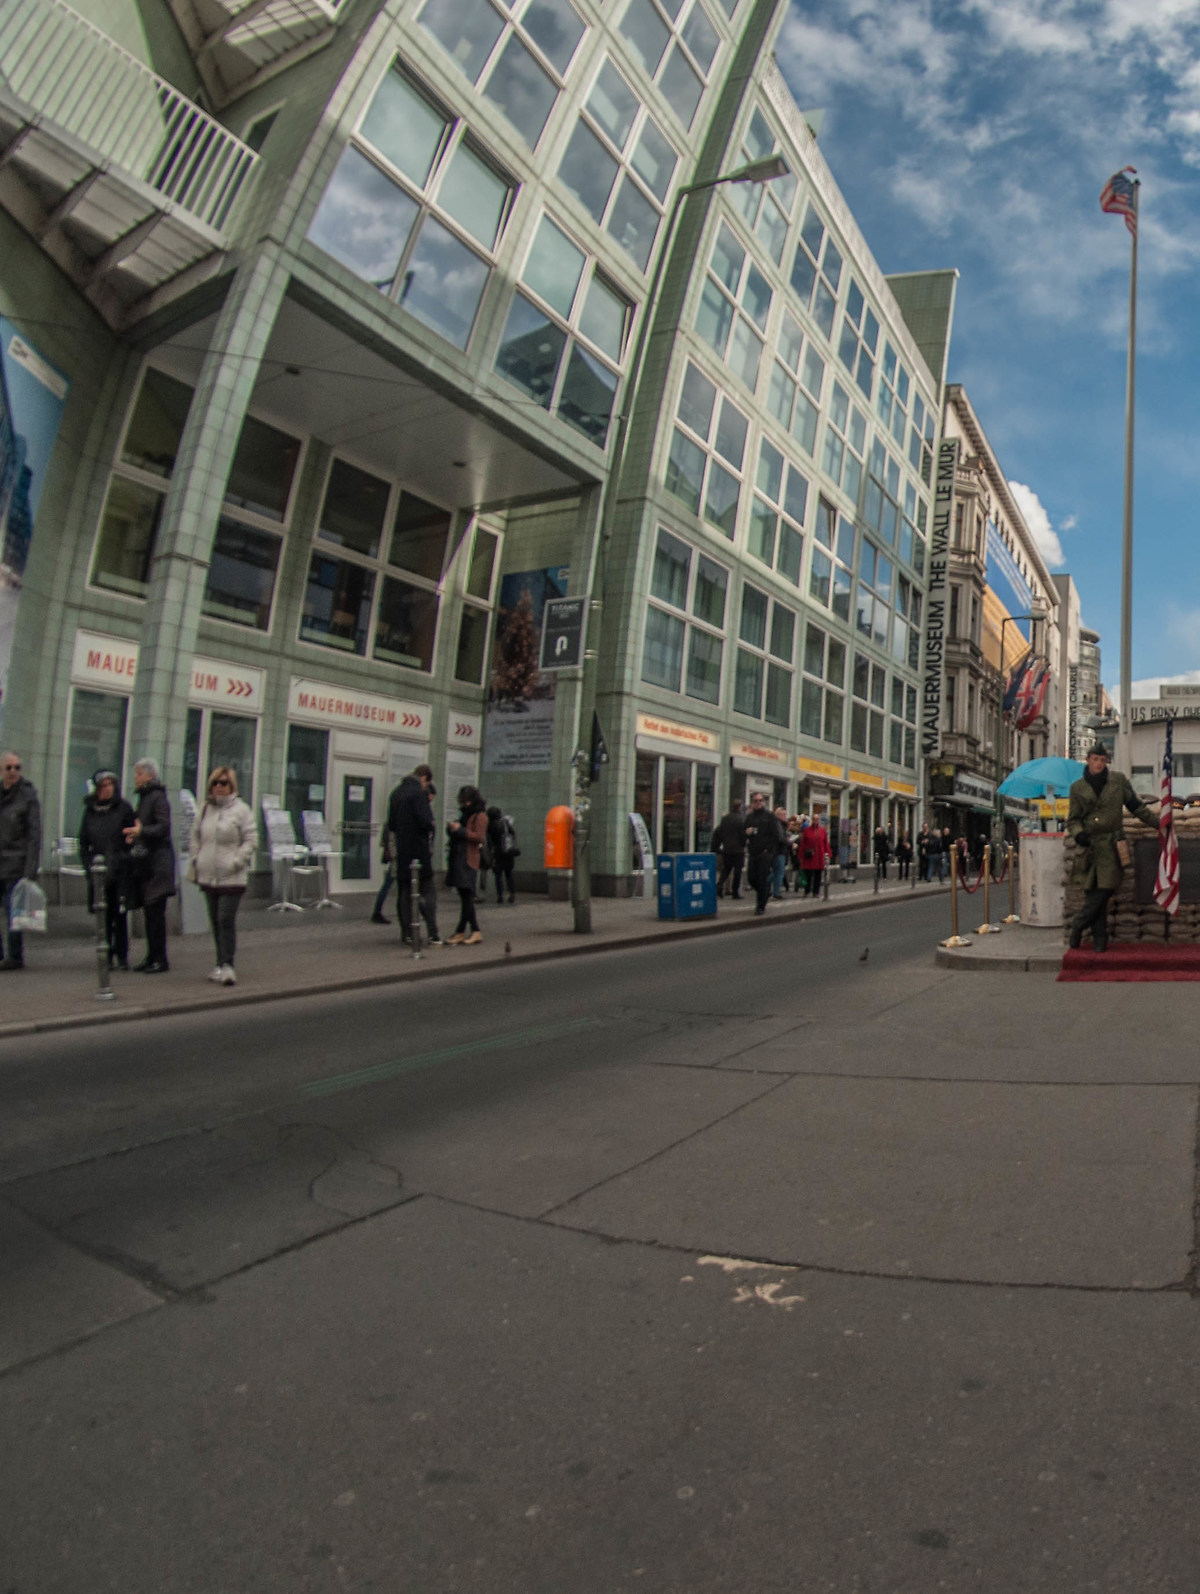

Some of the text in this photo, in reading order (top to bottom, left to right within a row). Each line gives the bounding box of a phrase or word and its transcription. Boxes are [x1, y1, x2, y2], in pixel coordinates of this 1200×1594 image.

[922, 442, 956, 750] MAUERMUSEUM THE WALL LE MUR
[297, 692, 397, 724] MAUERMUSEUM
[1150, 706, 1179, 720] ARMY
